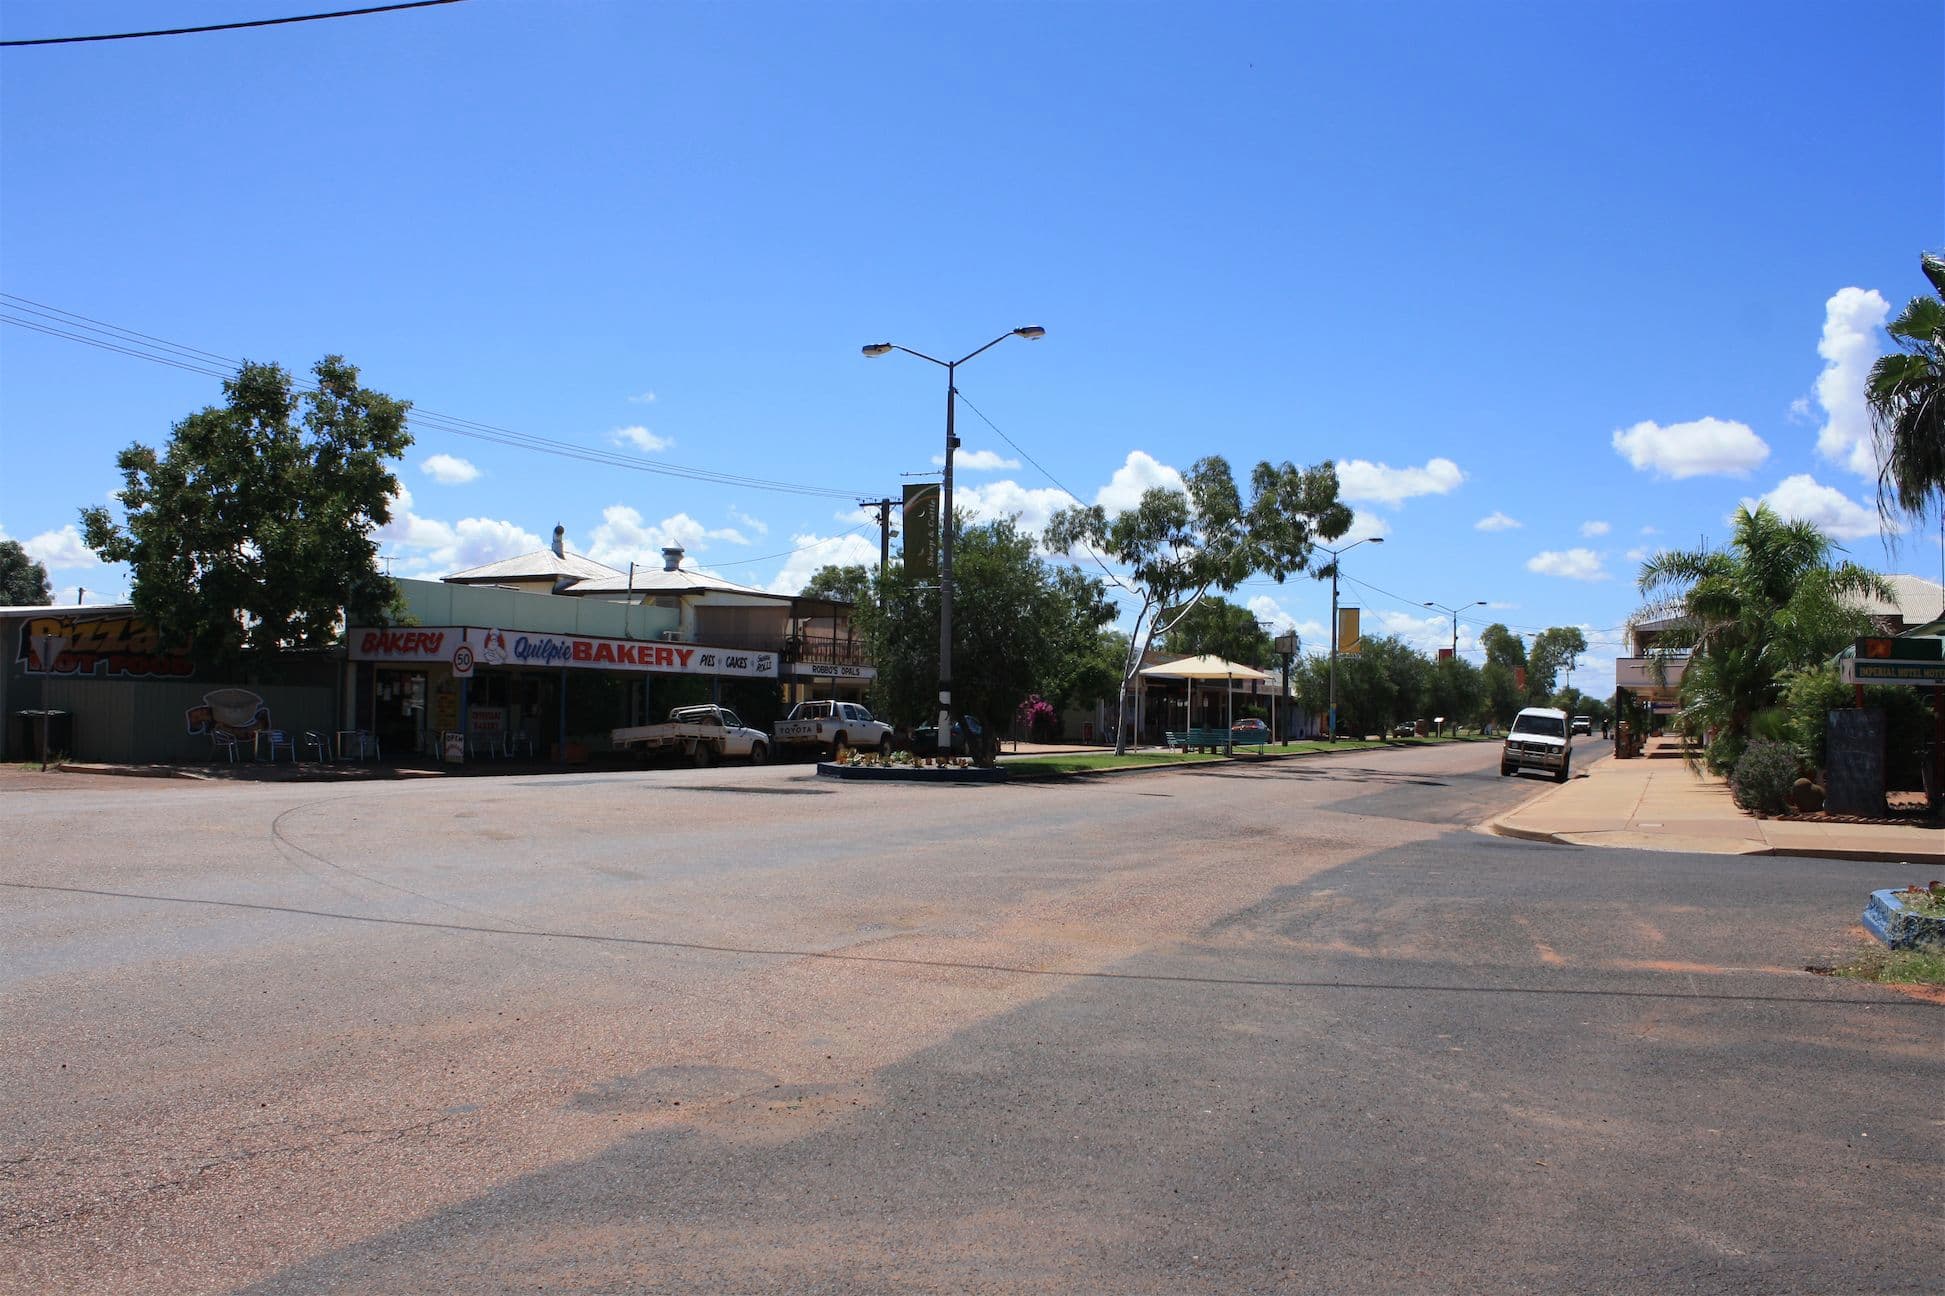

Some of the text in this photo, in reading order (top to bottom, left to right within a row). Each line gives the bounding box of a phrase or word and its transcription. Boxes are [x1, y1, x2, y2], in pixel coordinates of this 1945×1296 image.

[928, 499, 936, 527] Cattle
[928, 541, 937, 567] Sheep
[361, 631, 444, 652] BAKERY
[514, 636, 694, 667] Quilpie BAKERY
[458, 653, 470, 666] 50
[699, 654, 715, 667] PIES
[725, 655, 748, 669] CAKES
[812, 664, 860, 676] ROBBO'S OPALS
[1860, 666, 1896, 677] IMPERIAL
[1898, 667, 1920, 678] HOTEL
[779, 726, 811, 735] TOYOTA
